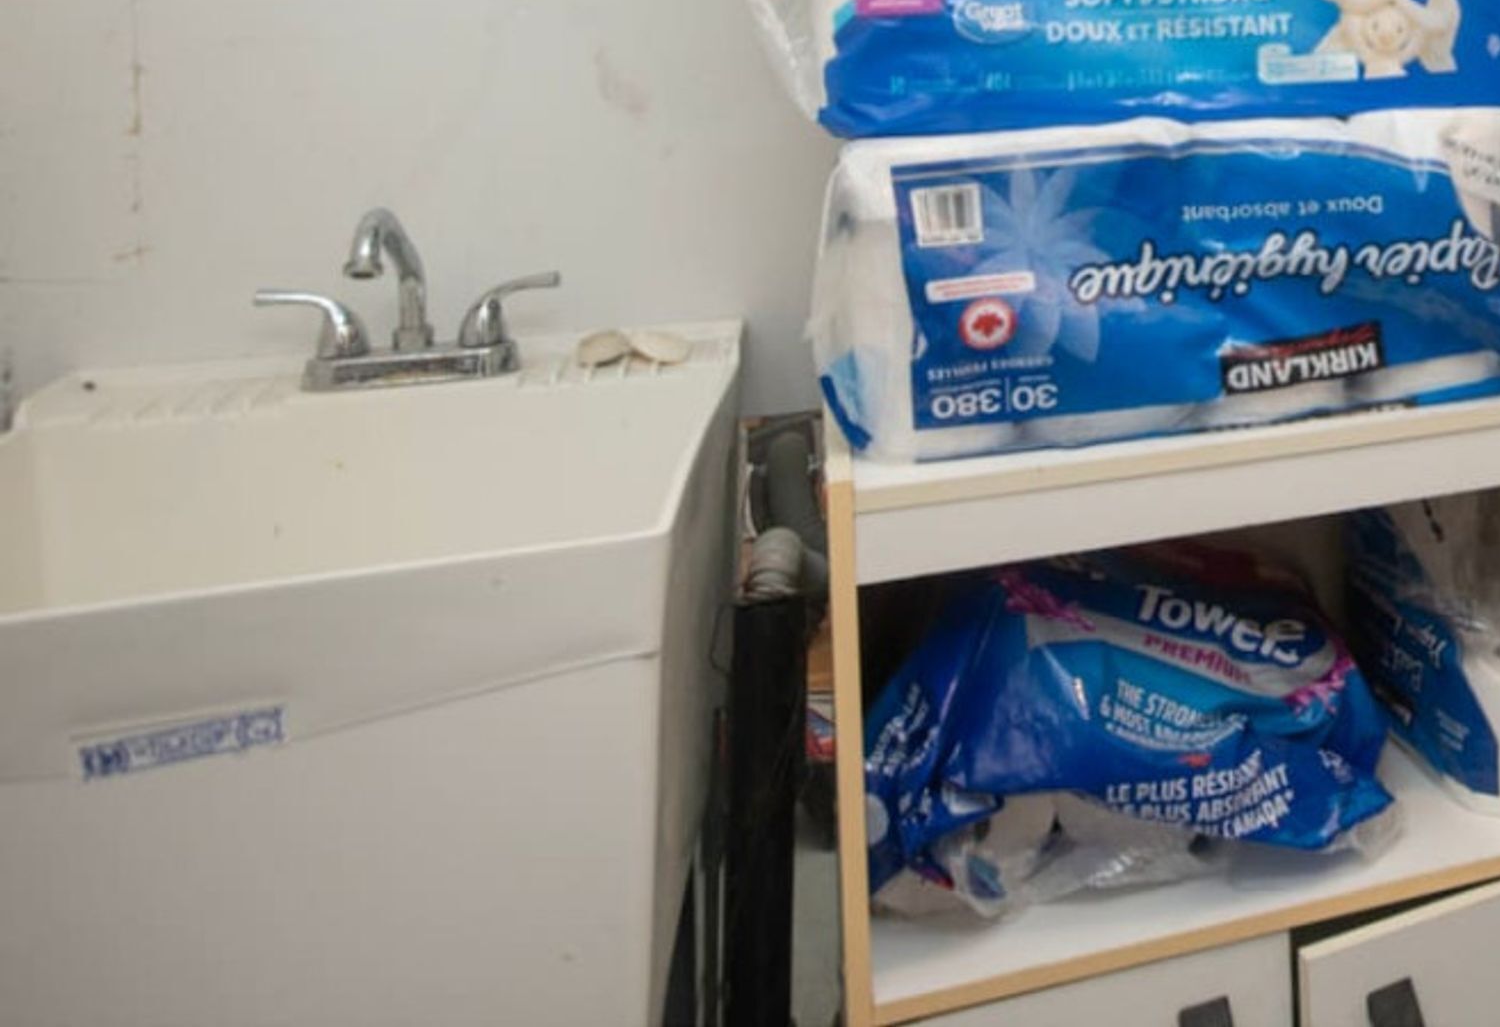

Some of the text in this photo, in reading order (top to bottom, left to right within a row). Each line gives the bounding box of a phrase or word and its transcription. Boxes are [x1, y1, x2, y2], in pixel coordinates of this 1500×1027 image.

[1046, 21, 1123, 43] DOUX
[1156, 12, 1293, 41] RÉSISTANT
[1182, 194, 1384, 222] Doux et absorbant
[1069, 219, 1500, 303] Papier hygiénique
[1226, 342, 1379, 390] KIRKLAND
[930, 387, 1003, 419] 380
[1011, 383, 1059, 412] 30
[1117, 677, 1145, 709] THE
[1105, 783, 1131, 803] LE
[1135, 777, 1188, 802] PLUS
